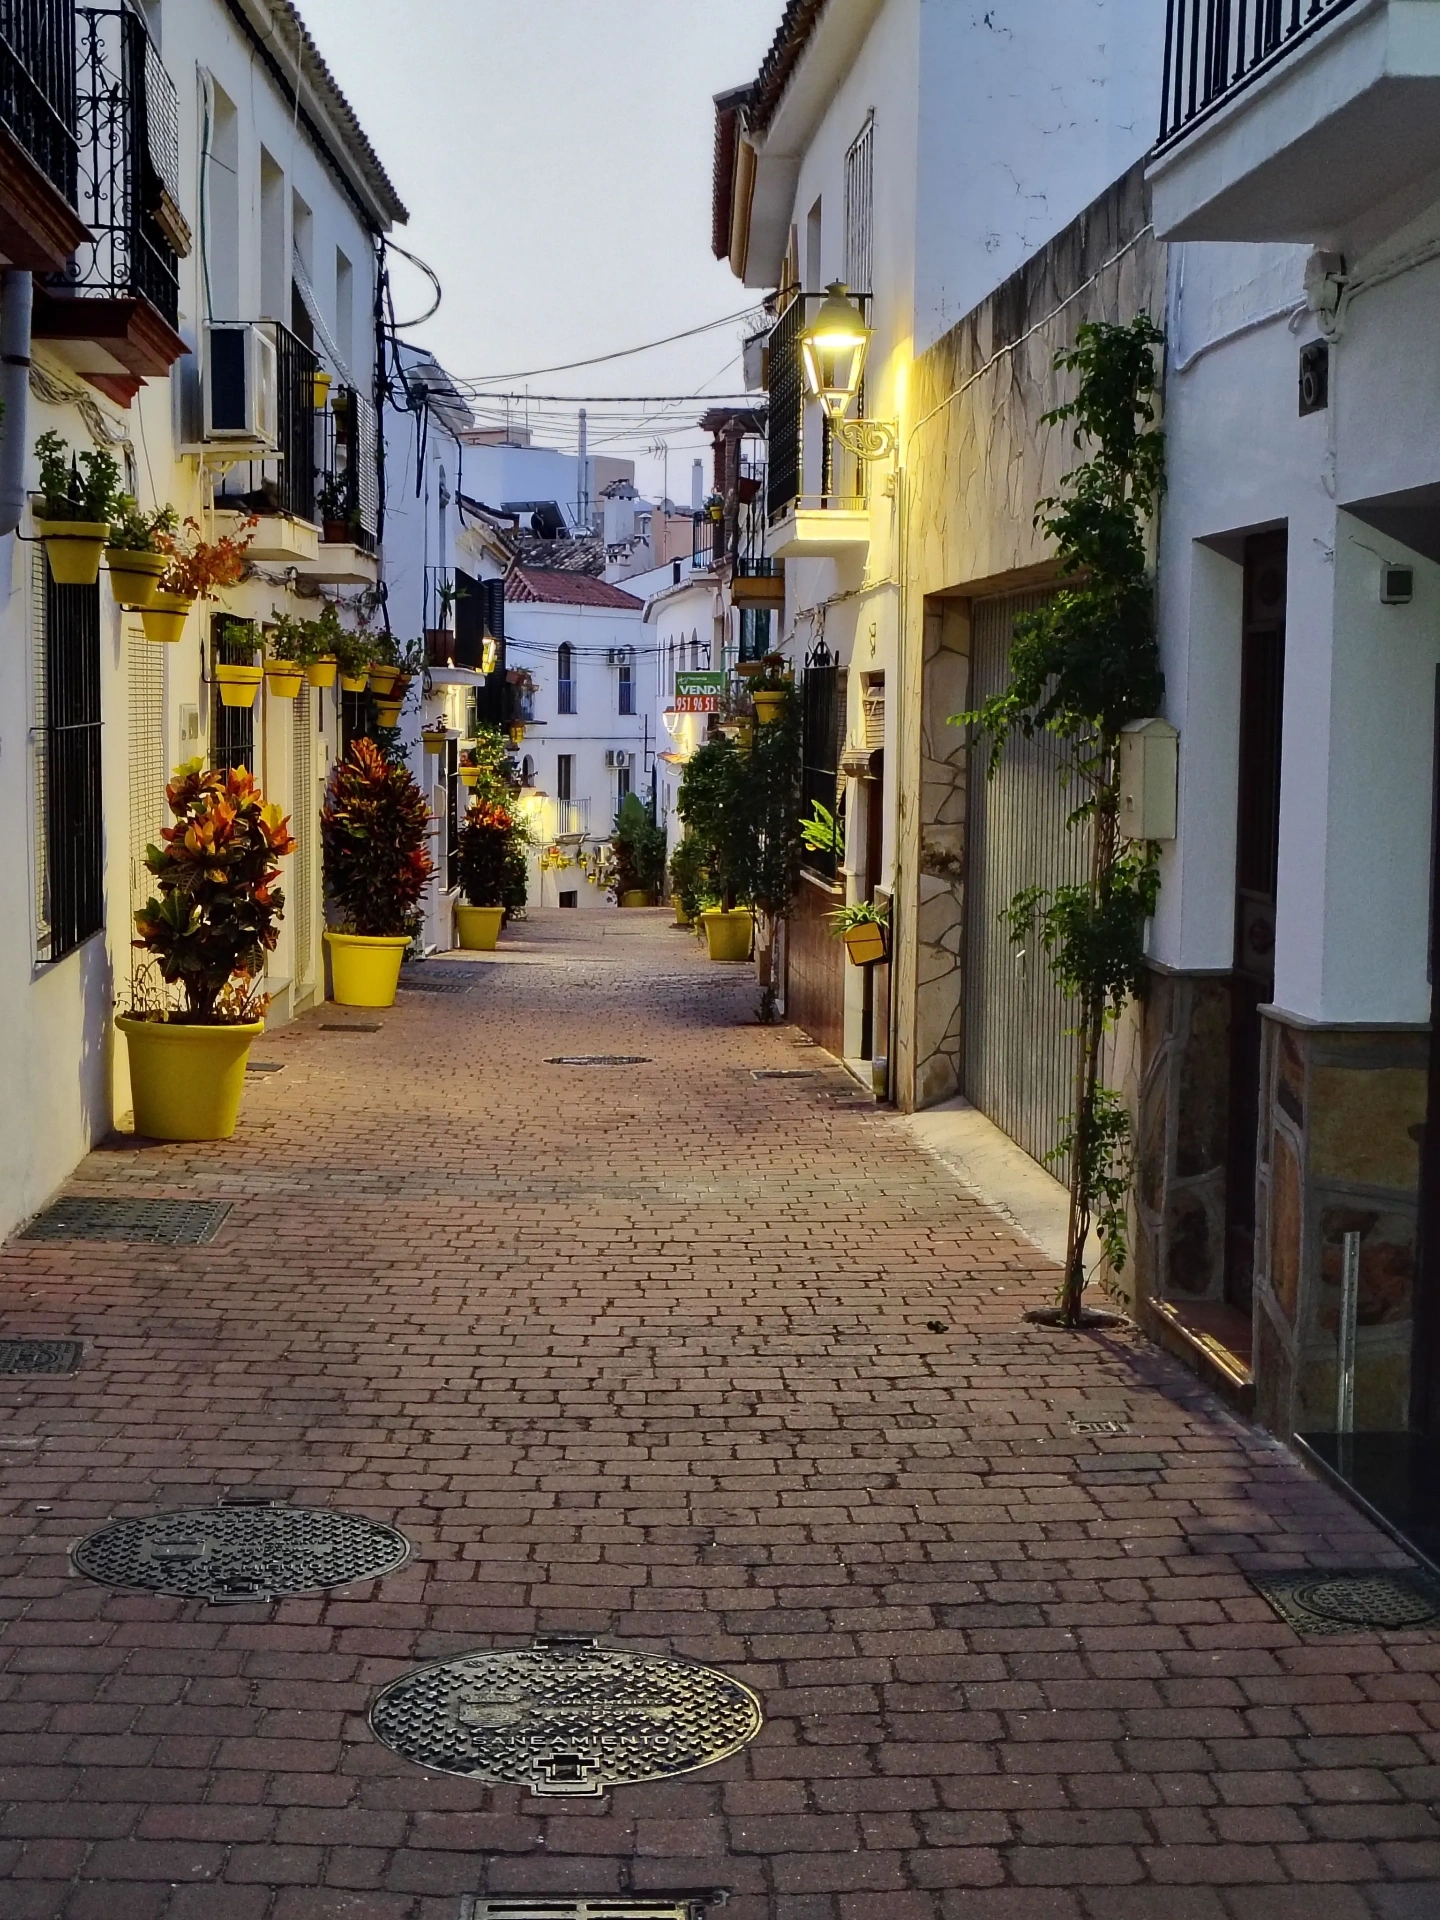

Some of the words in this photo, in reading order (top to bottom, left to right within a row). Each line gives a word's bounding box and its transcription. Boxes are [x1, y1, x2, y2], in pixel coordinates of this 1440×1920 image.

[1300, 346, 1316, 405] 6
[676, 697, 690, 711] 951
[693, 697, 703, 711] 96
[705, 697, 714, 711] 51
[471, 1736, 669, 1746] SANEAMIENTO
